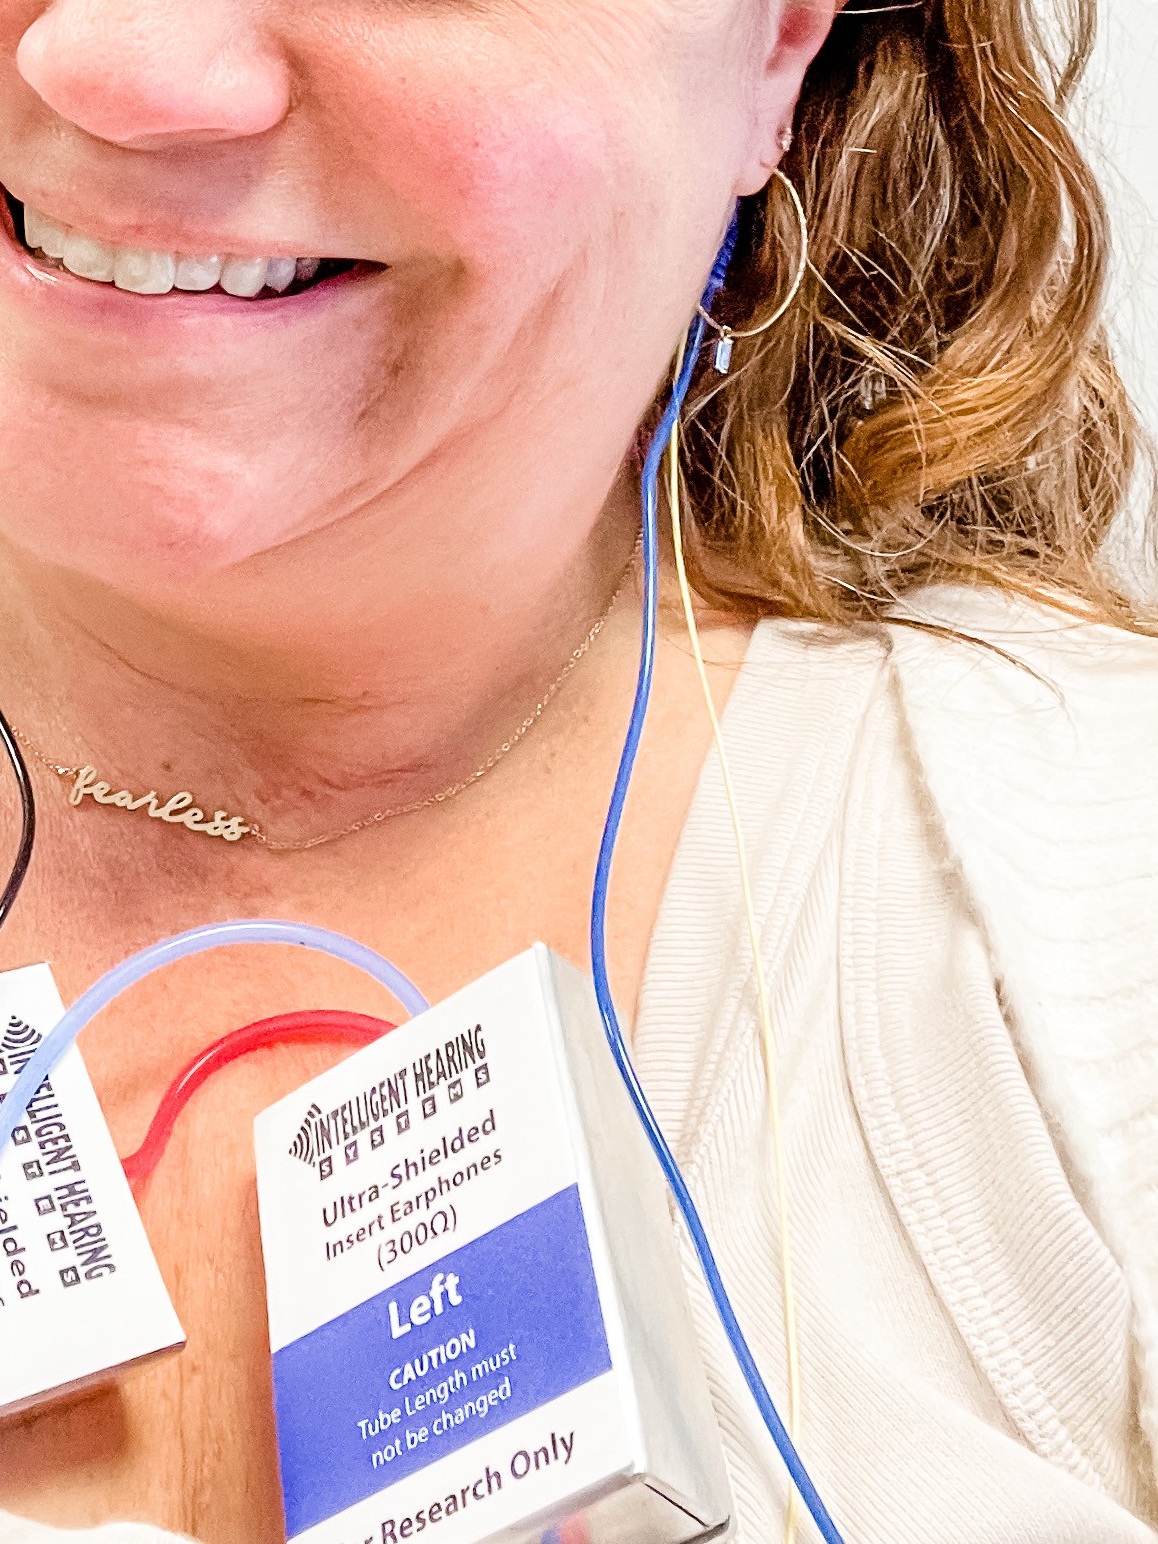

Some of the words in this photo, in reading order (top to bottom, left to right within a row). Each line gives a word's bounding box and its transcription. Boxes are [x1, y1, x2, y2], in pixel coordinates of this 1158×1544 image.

[68, 765, 244, 841] fearless
[314, 1067, 408, 1157] INTELLIGENT
[412, 1023, 487, 1098] HEARING
[6, 1047, 81, 1175] INELLIGENT
[53, 1178, 117, 1281] HEARING
[322, 1108, 497, 1228] Ultra-Shielded
[325, 1213, 385, 1261] Insert
[390, 1148, 503, 1224] Earphones
[377, 1204, 457, 1272] (300Ω)
[388, 1272, 462, 1340] Left
[357, 1408, 402, 1441] Tube
[404, 1369, 468, 1416] Length
[471, 1342, 518, 1382] must
[389, 1328, 476, 1391] CAUTION
[371, 1438, 402, 1469] not
[406, 1427, 429, 1450] be
[432, 1376, 512, 1436] changed
[381, 1465, 503, 1544] Research
[510, 1431, 575, 1481] Only
